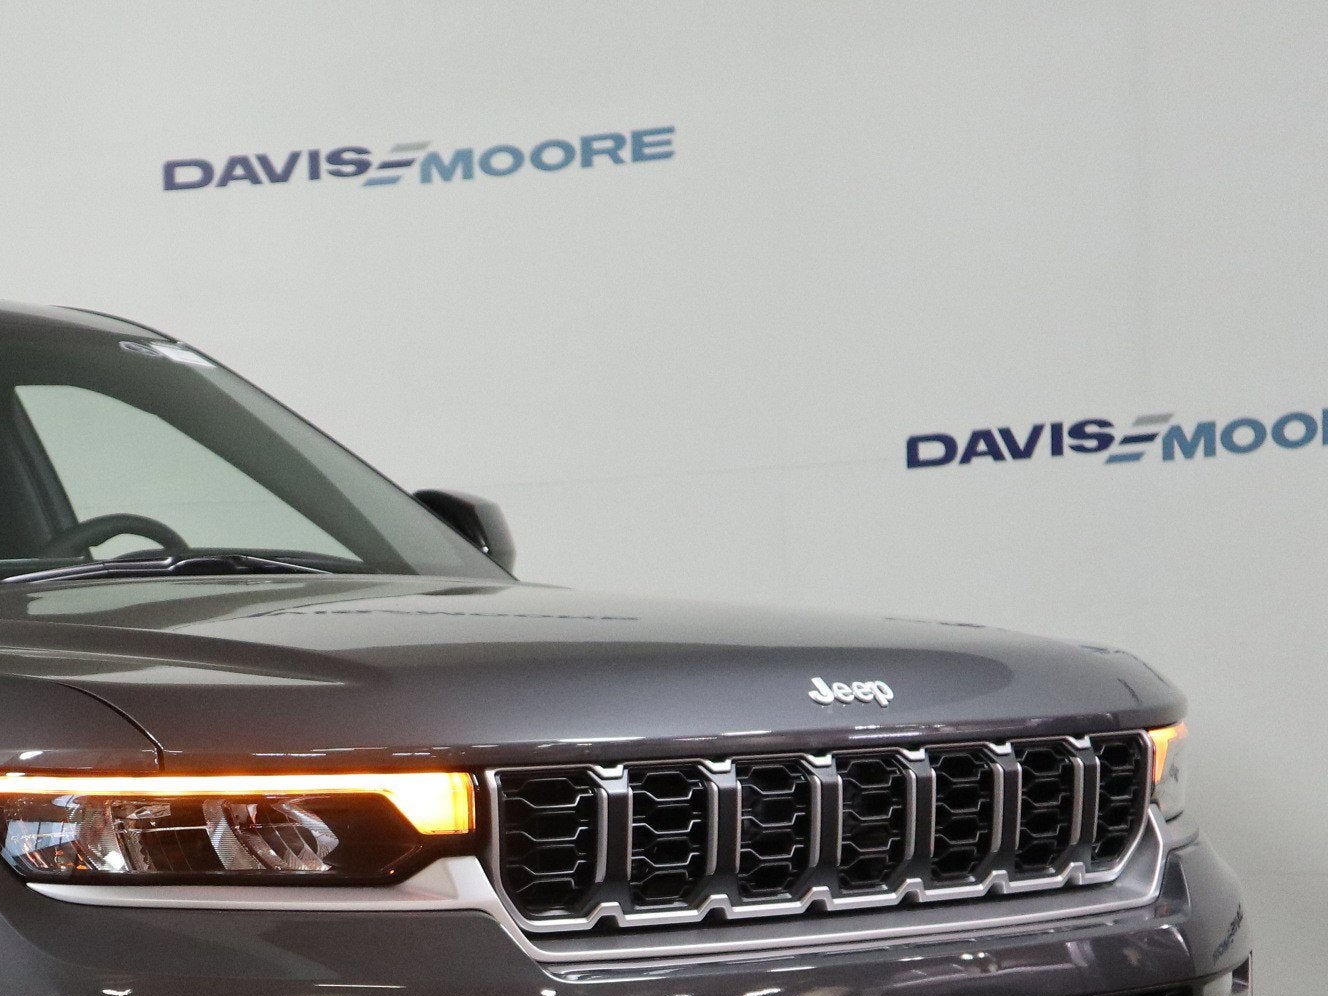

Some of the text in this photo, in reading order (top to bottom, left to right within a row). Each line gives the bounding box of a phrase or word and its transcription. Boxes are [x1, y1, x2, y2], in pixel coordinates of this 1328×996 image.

[161, 126, 676, 191] DAVIS MOORE
[906, 407, 1328, 469] DAVIS MOO
[807, 676, 894, 708] Jeep
